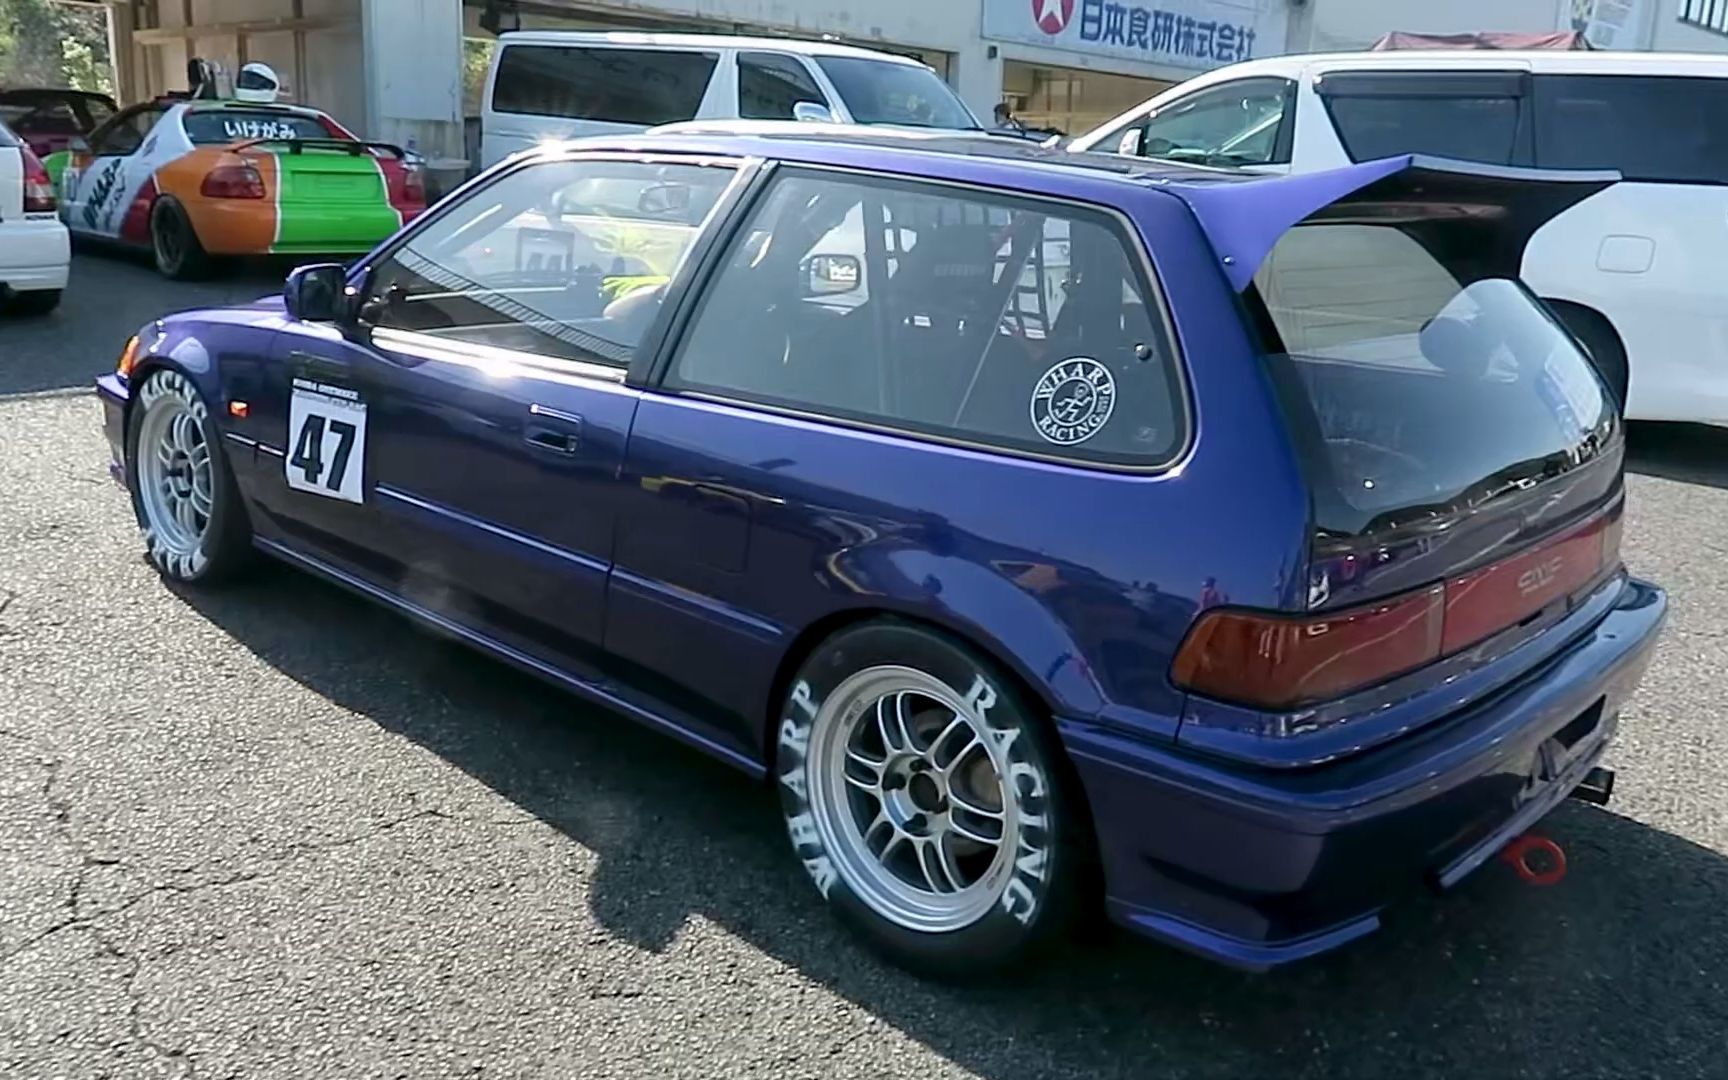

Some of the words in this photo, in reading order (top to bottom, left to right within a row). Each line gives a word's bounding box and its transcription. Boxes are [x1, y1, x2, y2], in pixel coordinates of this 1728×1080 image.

[1080, 0, 1256, 61] 日本食研株式会社
[223, 120, 297, 142] いけがみ
[139, 369, 208, 420] RACING
[1035, 362, 1113, 399] WHARP
[290, 413, 357, 493] 47
[1038, 413, 1101, 441] RACING
[778, 679, 837, 901] WHARP
[963, 673, 1049, 925] RACING
